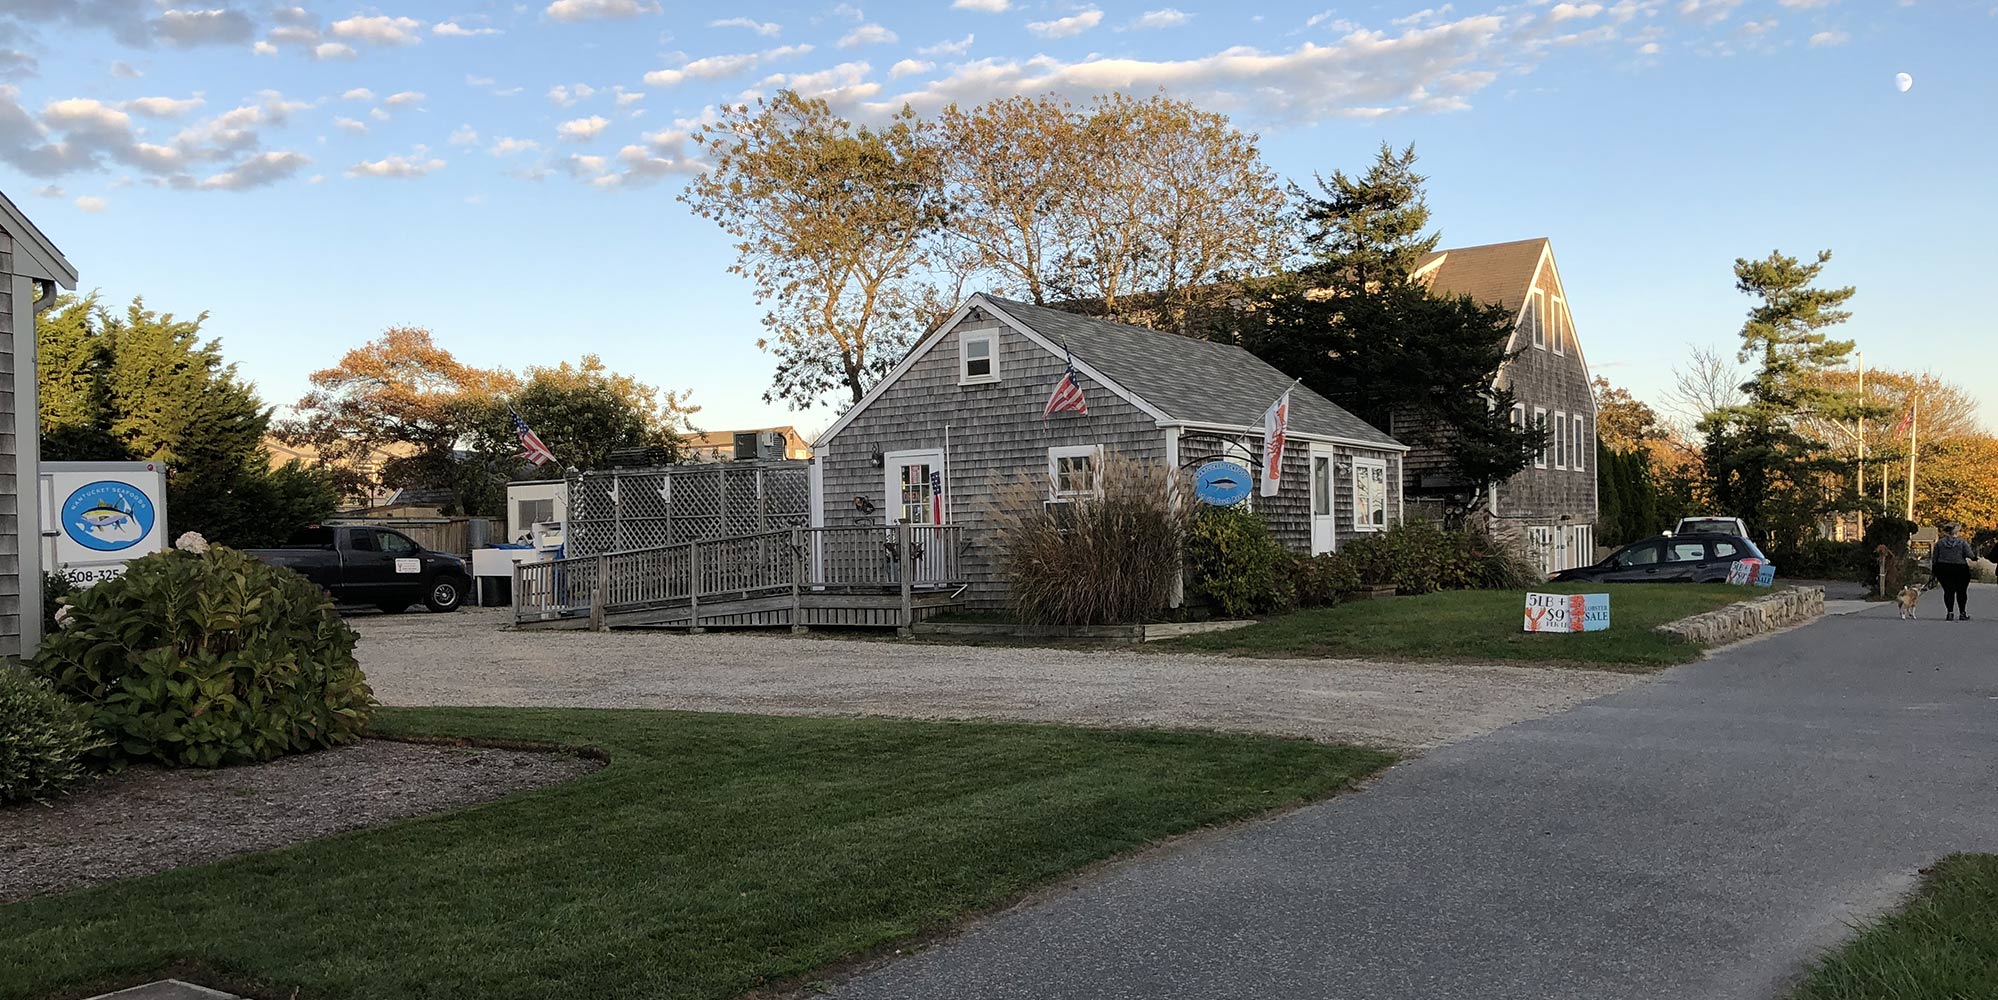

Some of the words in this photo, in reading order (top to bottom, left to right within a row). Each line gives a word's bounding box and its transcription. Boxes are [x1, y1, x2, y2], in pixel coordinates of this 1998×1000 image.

[71, 487, 110, 510] NANTUCKET
[112, 487, 146, 509] SEAFOODS
[1529, 594, 1554, 608] 5LB
[1585, 611, 1609, 621] SALE
